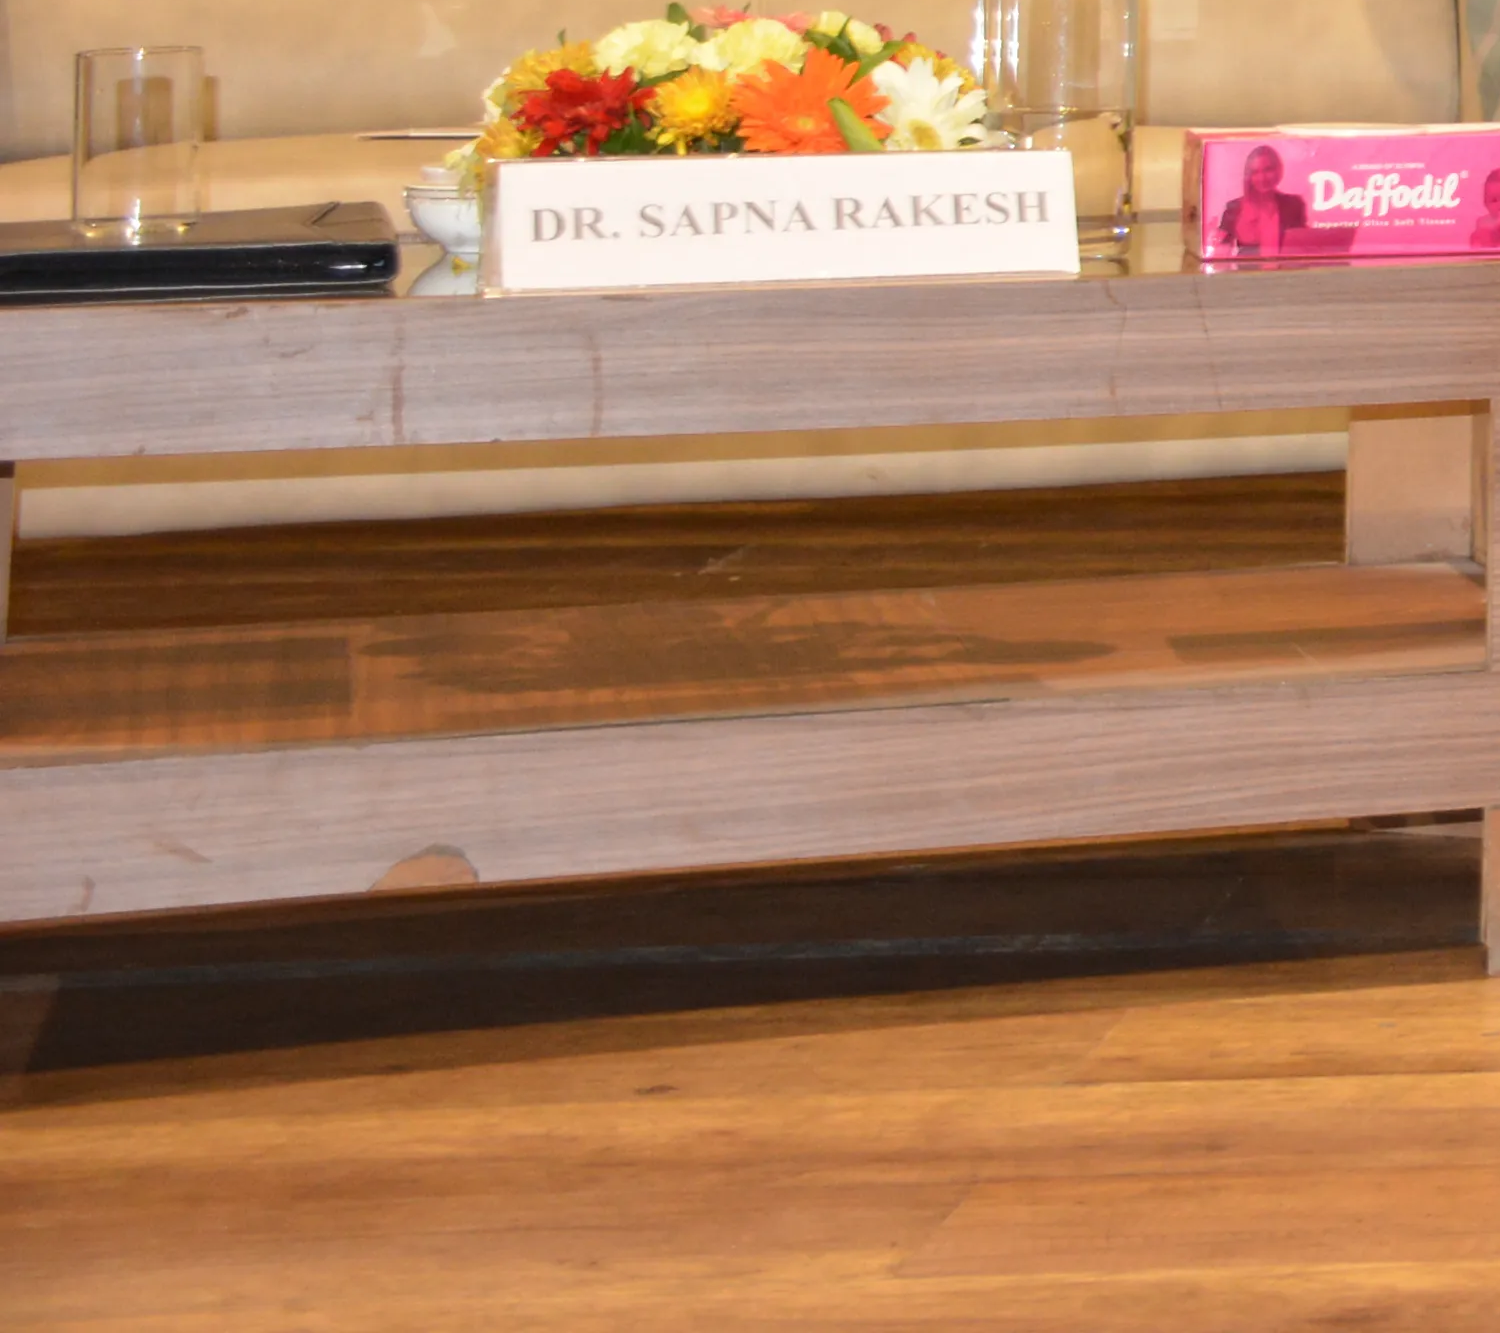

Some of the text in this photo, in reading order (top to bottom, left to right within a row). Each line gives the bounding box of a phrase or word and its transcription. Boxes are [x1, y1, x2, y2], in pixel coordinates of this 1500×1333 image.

[530, 189, 1051, 243] DR. SAPNA RAKESH
[1308, 169, 1461, 217] Daffodil
